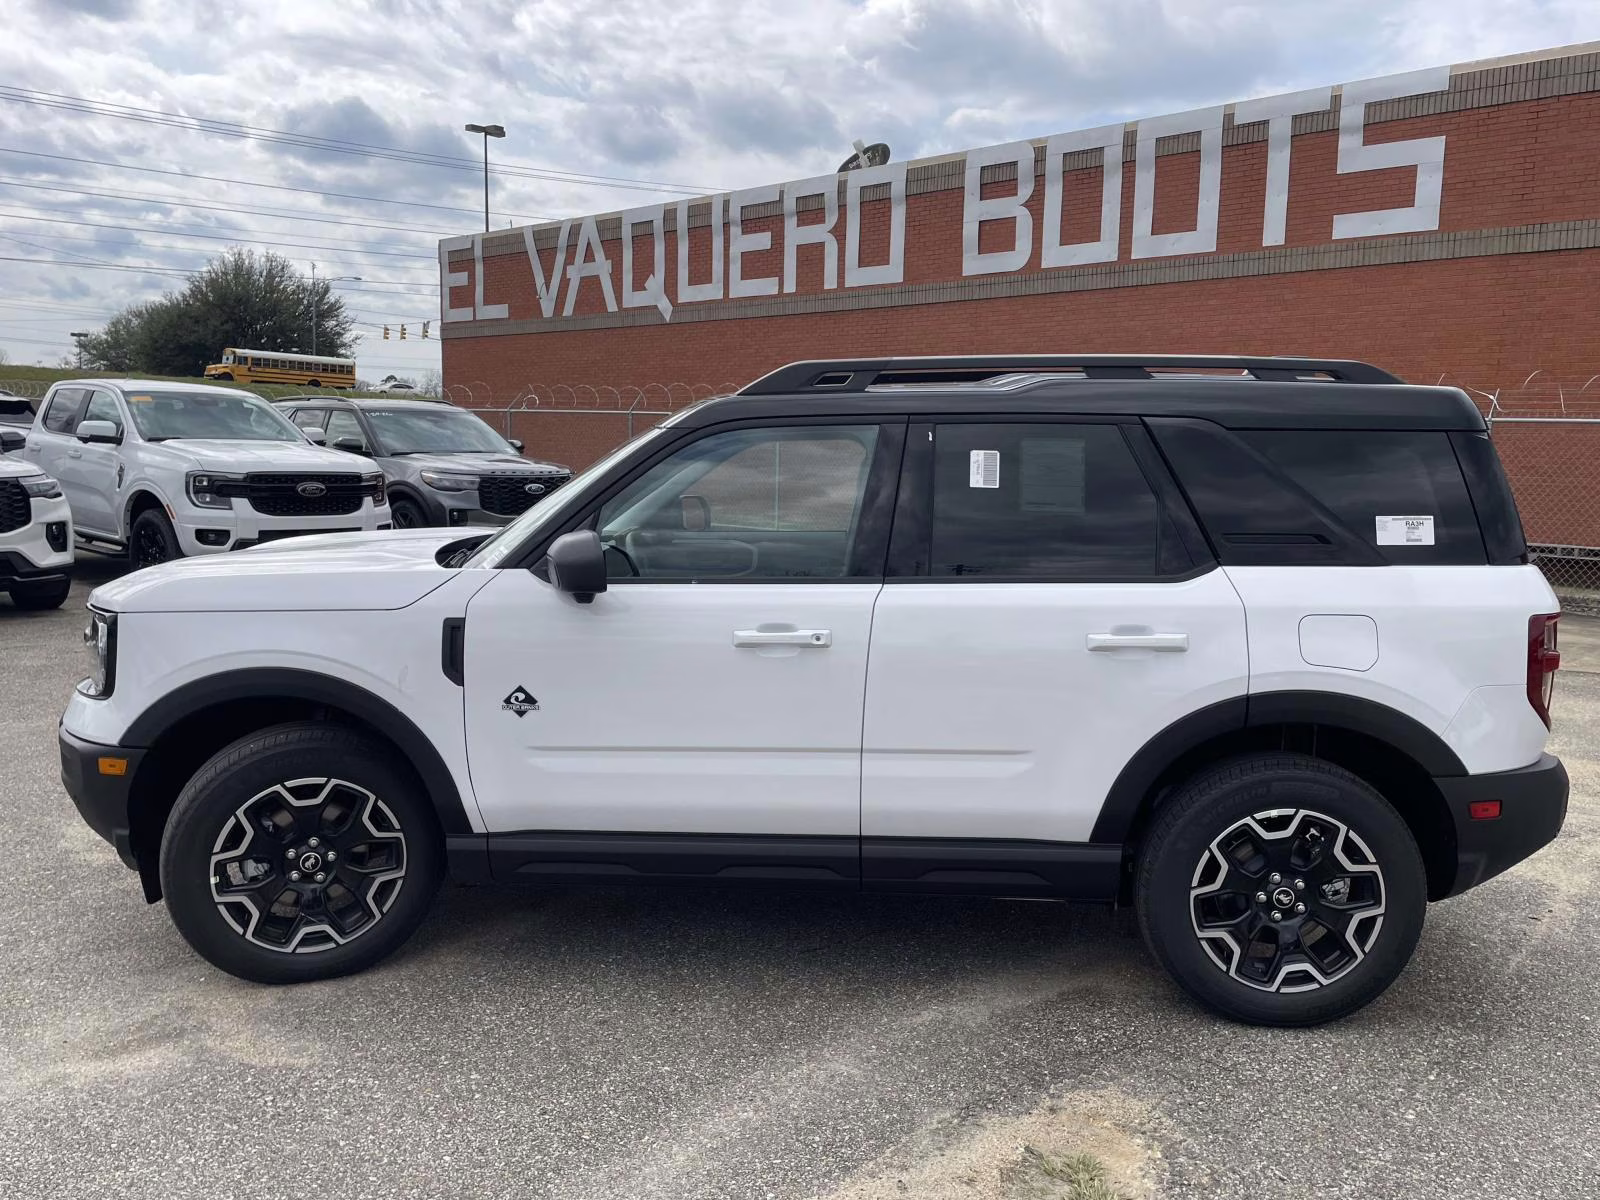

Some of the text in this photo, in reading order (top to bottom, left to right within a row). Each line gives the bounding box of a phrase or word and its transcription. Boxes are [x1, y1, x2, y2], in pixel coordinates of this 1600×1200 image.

[439, 65, 1451, 323] EL VAQUERO BOOTS
